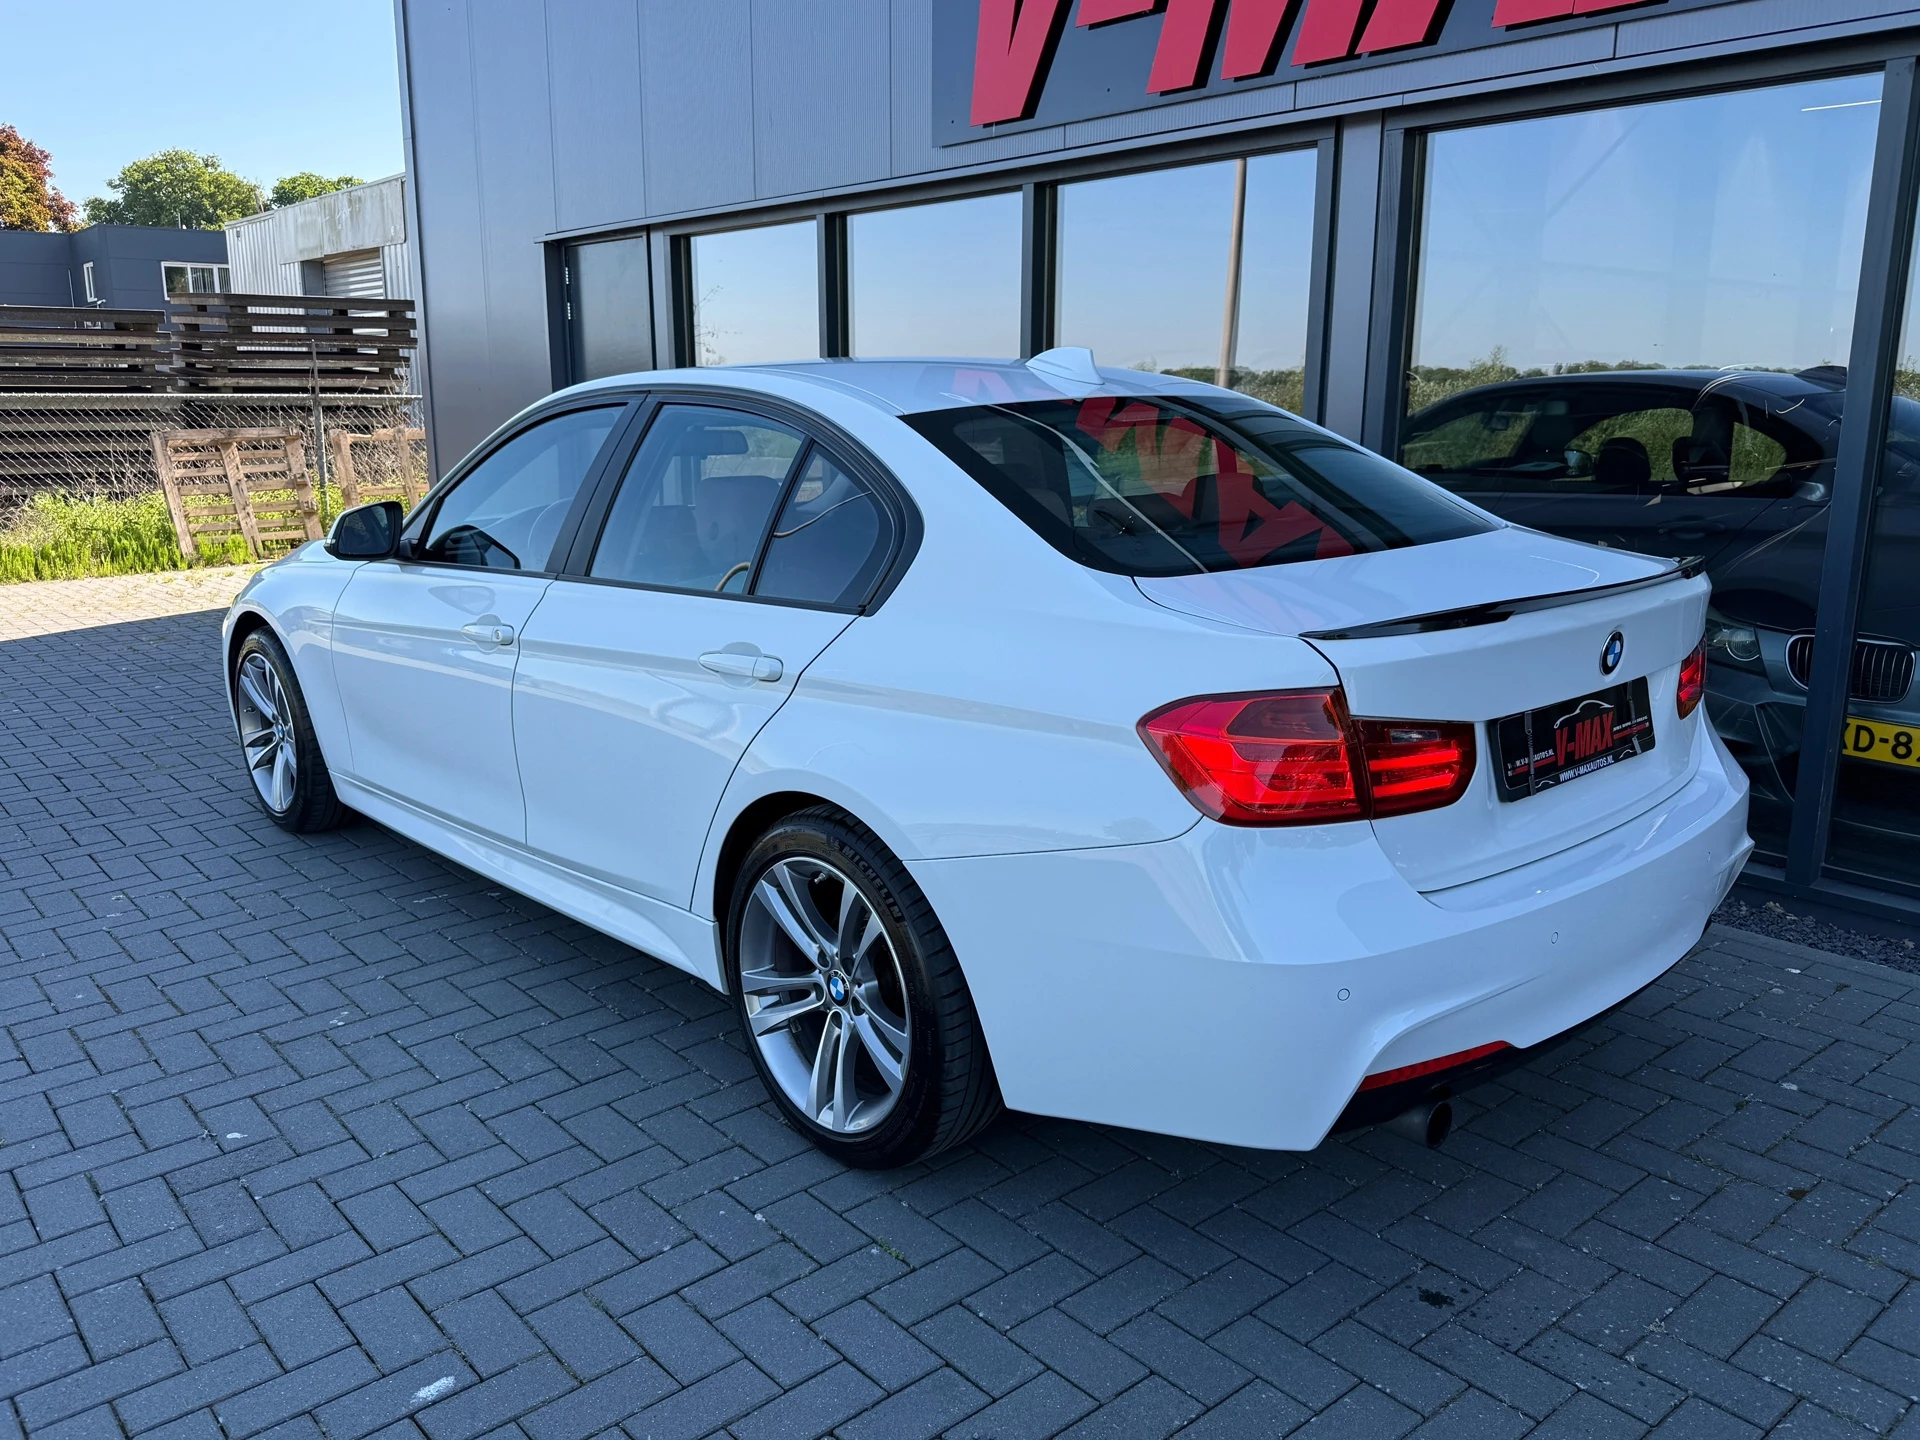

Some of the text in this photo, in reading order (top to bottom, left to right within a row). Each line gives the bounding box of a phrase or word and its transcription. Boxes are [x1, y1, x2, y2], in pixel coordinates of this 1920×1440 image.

[1555, 711, 1614, 766] V-MAX
[1559, 754, 1615, 783] WWW.V-MAXAUTOS.NL
[841, 844, 902, 921] MICHELIN
